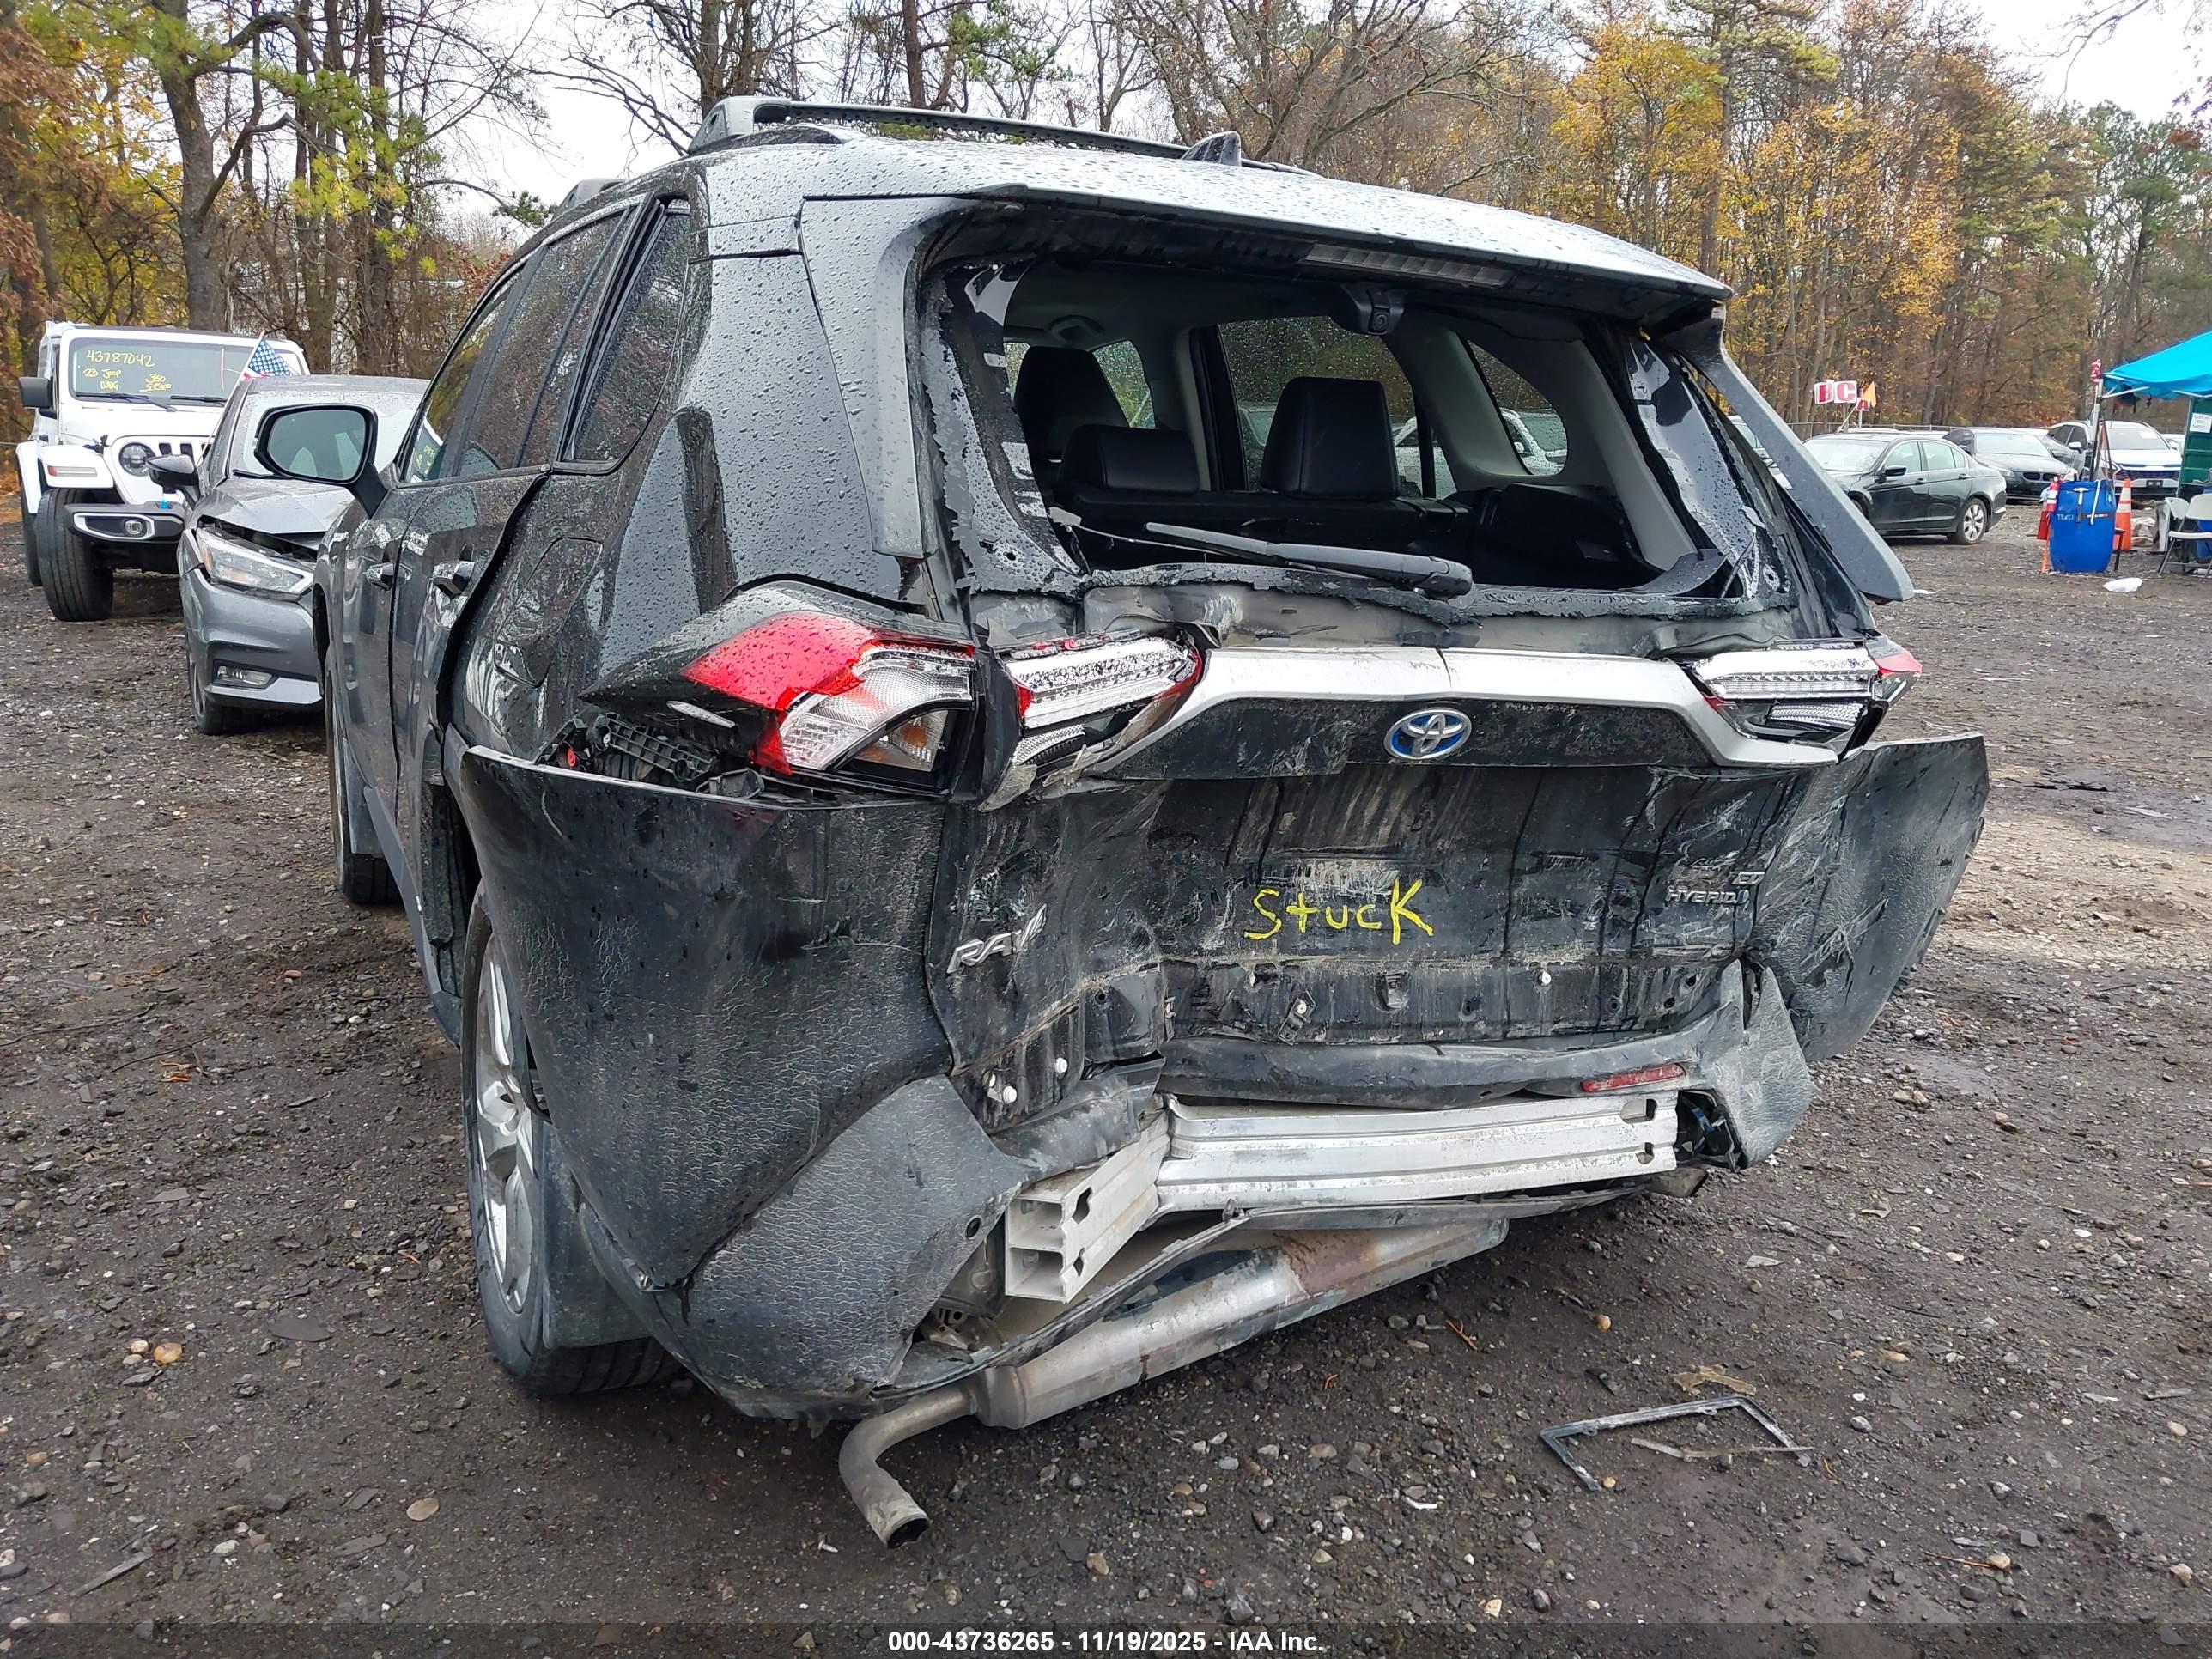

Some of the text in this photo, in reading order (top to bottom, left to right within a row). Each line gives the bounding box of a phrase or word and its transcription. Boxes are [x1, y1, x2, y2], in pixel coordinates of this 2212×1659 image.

[87, 350, 155, 367] 43787042
[1837, 383, 1856, 401] C
[1857, 399, 1869, 410] A
[1665, 887, 1737, 904] HYBRID
